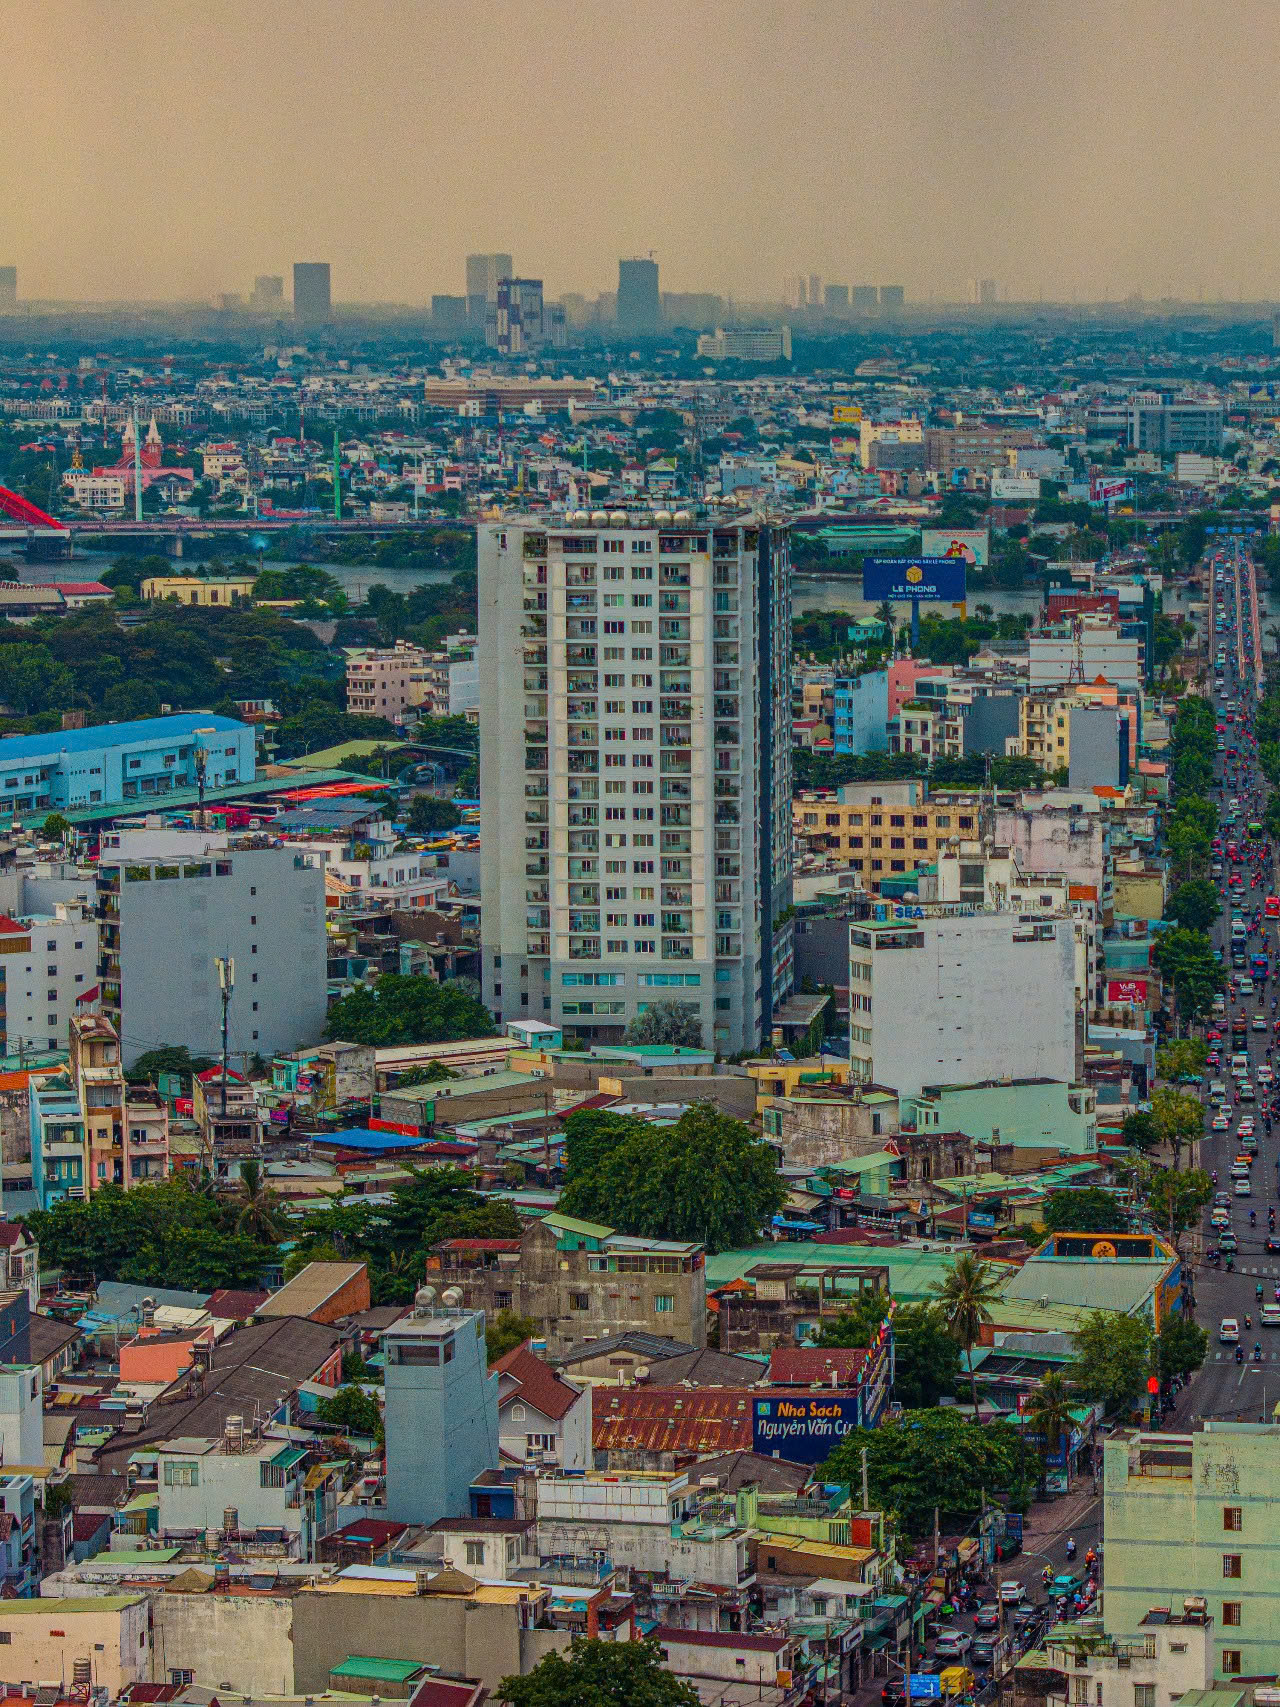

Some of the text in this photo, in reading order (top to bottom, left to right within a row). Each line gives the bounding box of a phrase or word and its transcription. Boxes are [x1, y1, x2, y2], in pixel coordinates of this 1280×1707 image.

[905, 585, 937, 593] PHONG
[895, 906, 924, 918] SEA
[777, 1401, 842, 1417] Nhà Sách
[757, 1419, 806, 1440] Nguyễn
[807, 1417, 832, 1435] Văn
